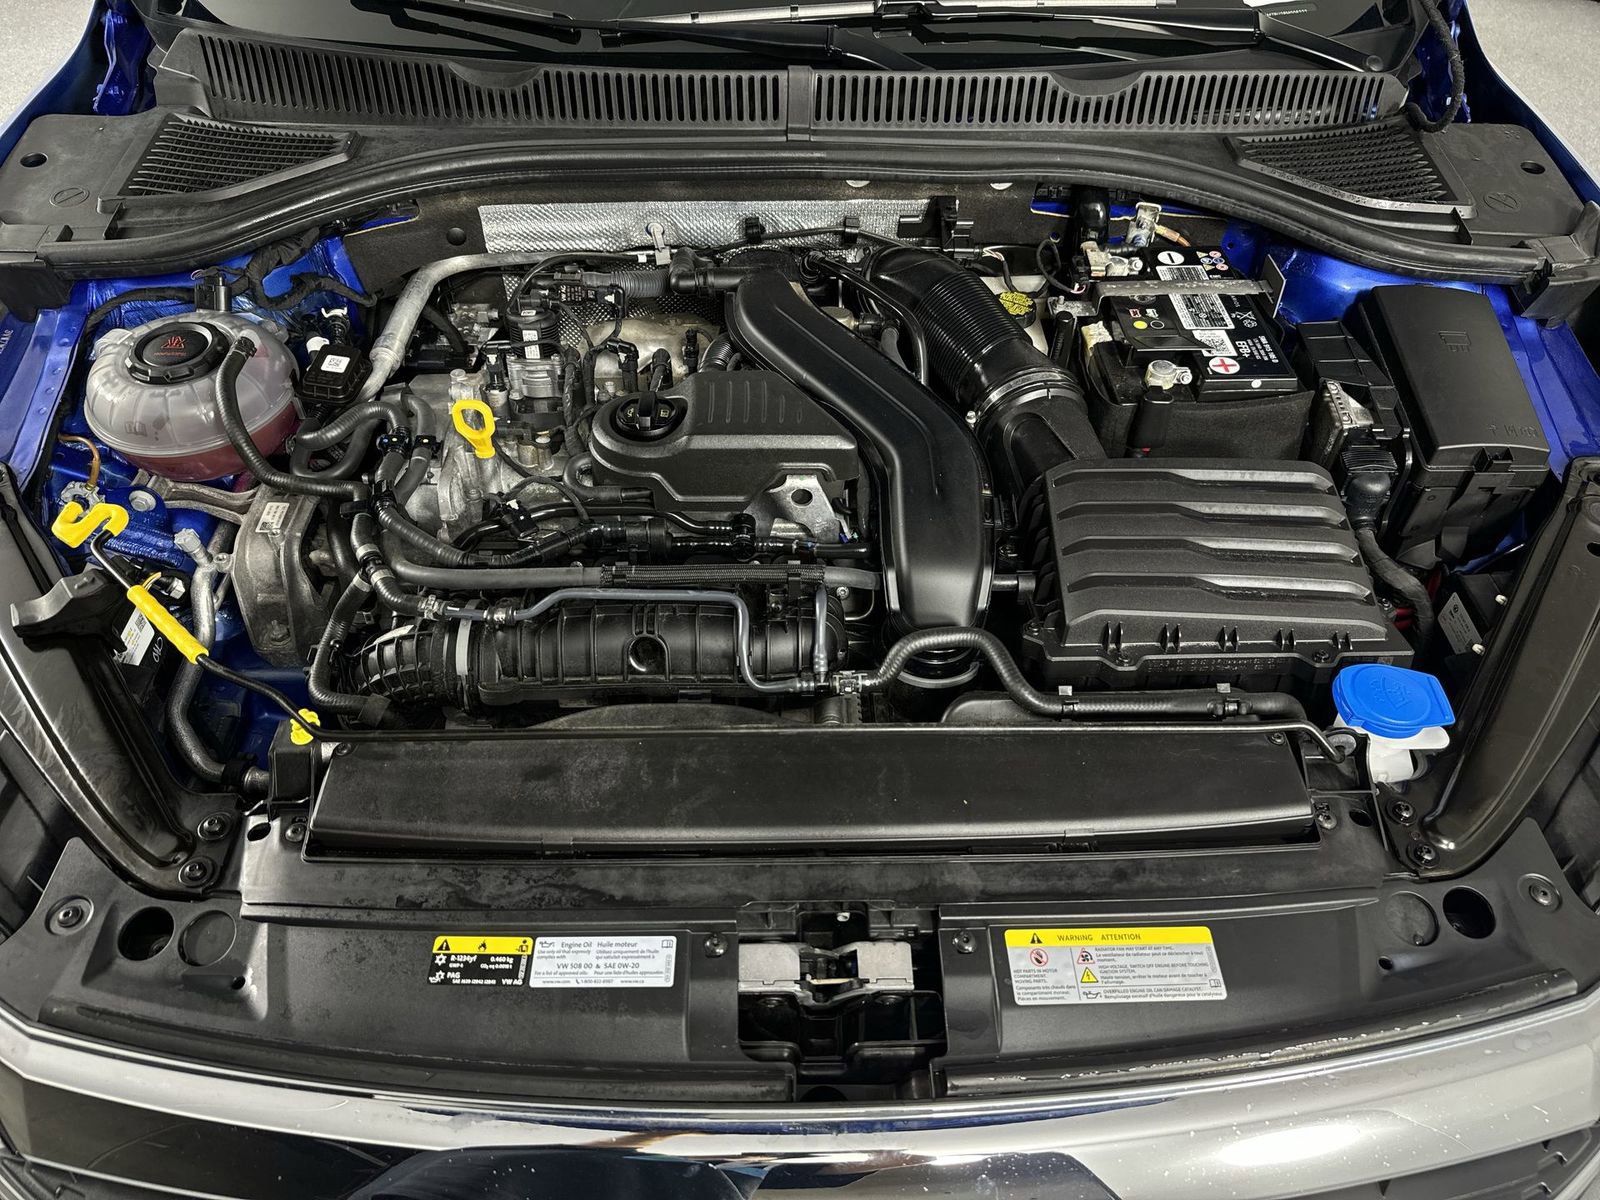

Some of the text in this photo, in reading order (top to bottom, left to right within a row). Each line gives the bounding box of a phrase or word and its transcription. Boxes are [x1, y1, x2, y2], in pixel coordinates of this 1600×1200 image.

[1235, 341, 1251, 358] EFB+
[561, 942, 582, 950] Engine
[450, 954, 477, 963] R-1234yf
